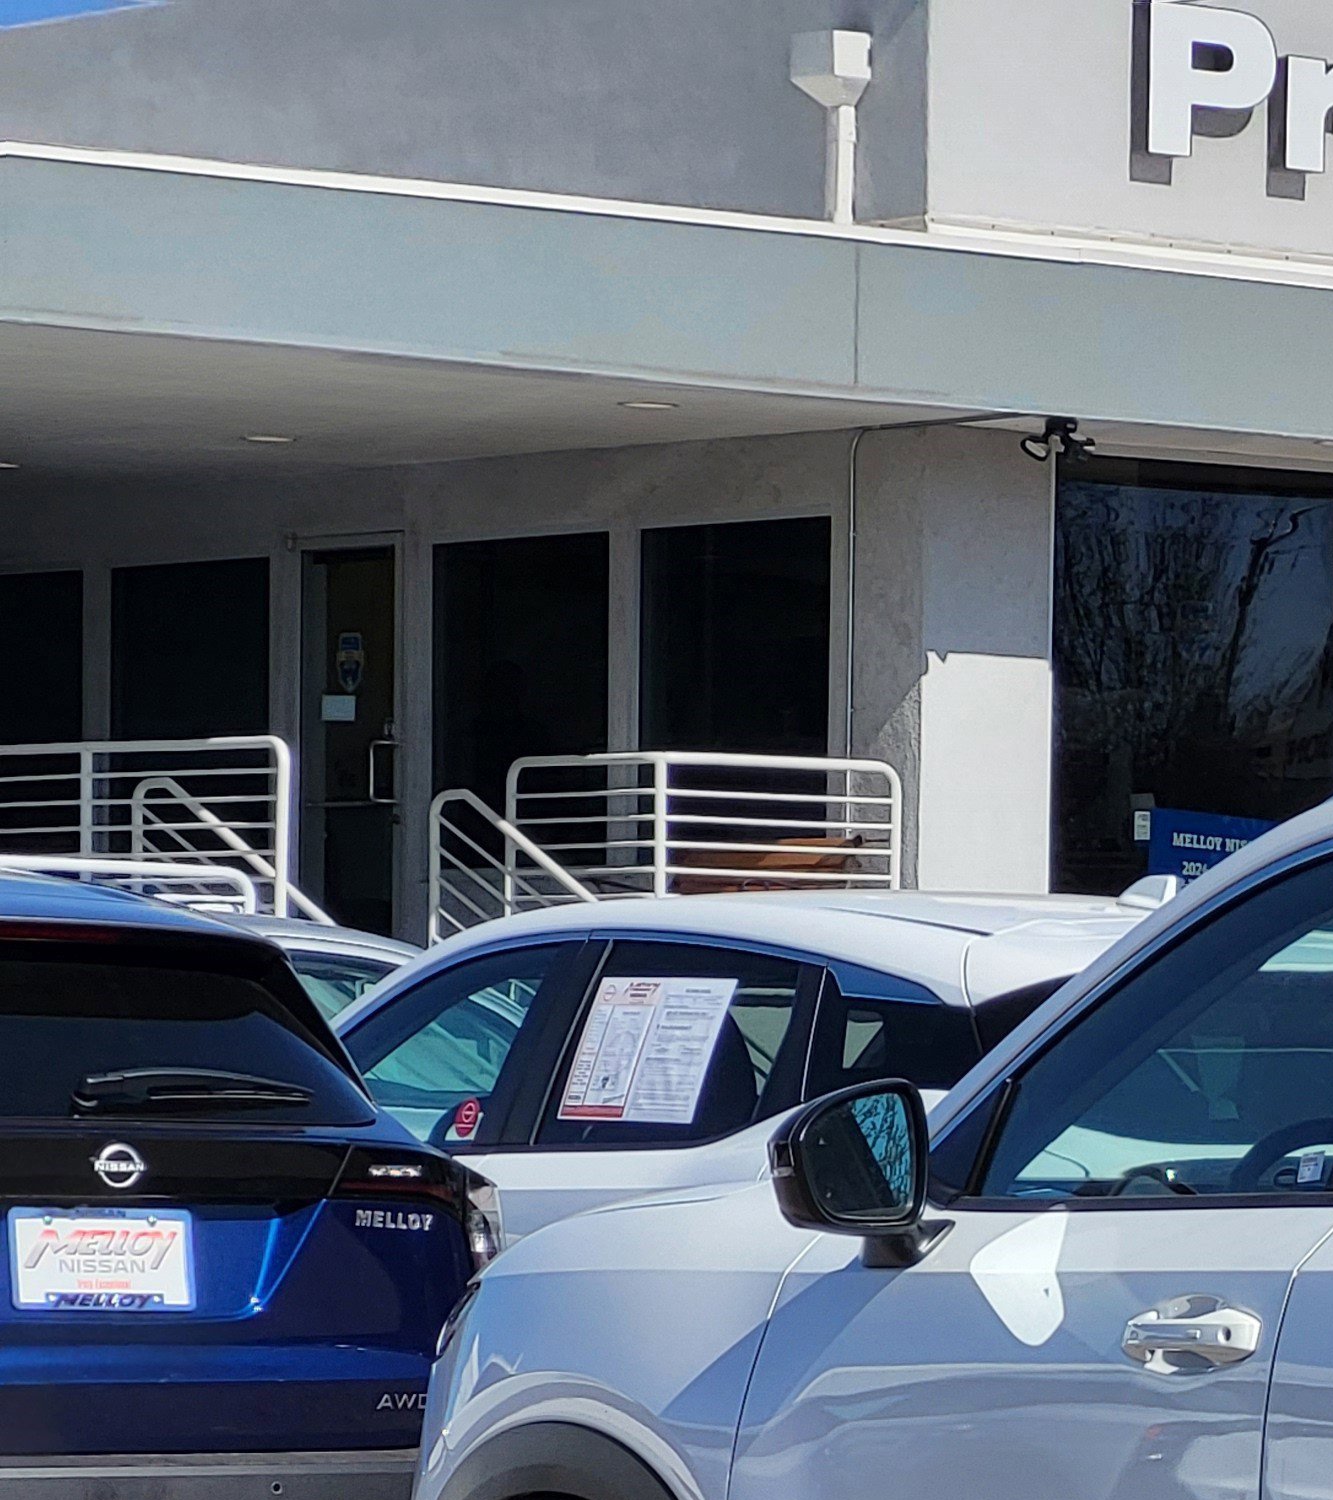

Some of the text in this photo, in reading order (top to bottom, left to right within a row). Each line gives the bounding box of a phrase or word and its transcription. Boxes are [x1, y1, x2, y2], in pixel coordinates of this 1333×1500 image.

[1172, 832, 1223, 852] MELLOY
[94, 1161, 145, 1172] NISSAN
[355, 1209, 434, 1231] MELLOY
[24, 1229, 178, 1270] MELLOY
[59, 1259, 146, 1274] NISSAN
[54, 1293, 150, 1308] MELLOY
